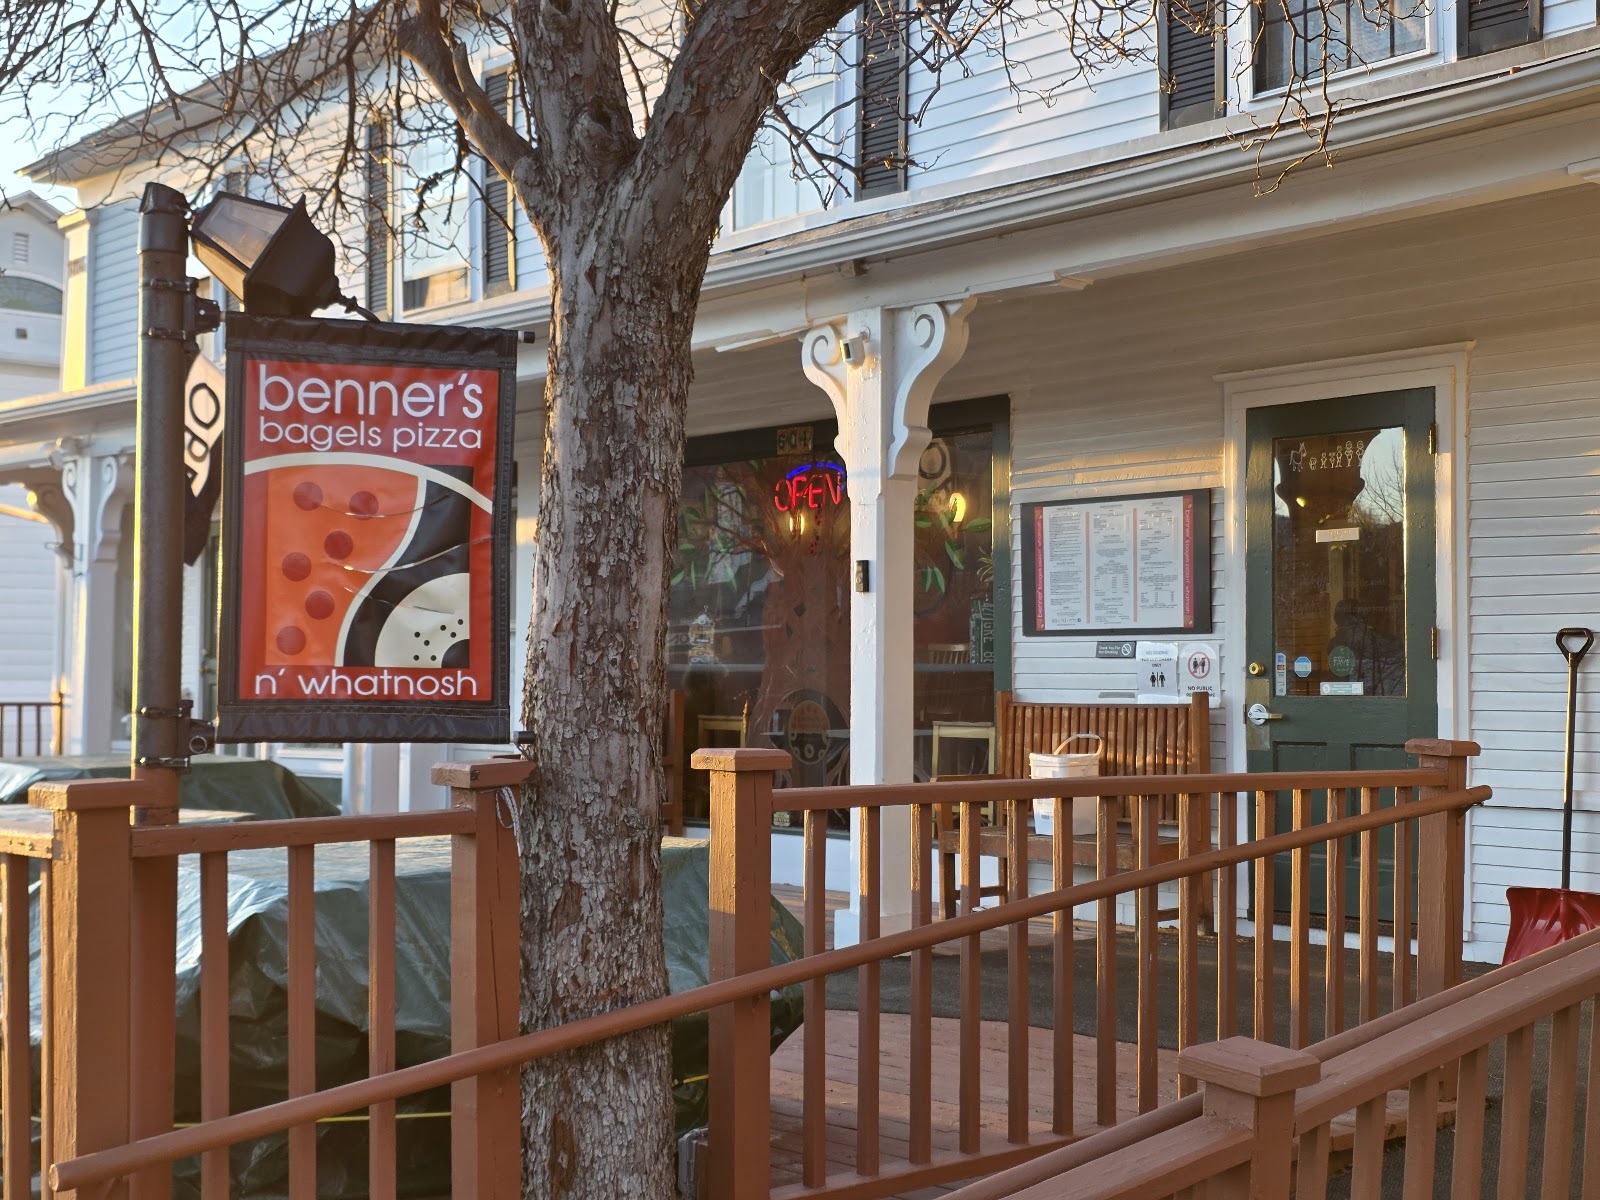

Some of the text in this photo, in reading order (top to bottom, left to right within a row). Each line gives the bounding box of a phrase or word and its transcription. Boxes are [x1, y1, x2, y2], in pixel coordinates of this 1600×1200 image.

[258, 364, 484, 419] benner's
[259, 416, 482, 453] bagels pizza
[774, 472, 842, 512] OPEN
[298, 669, 478, 697] whatnosh
